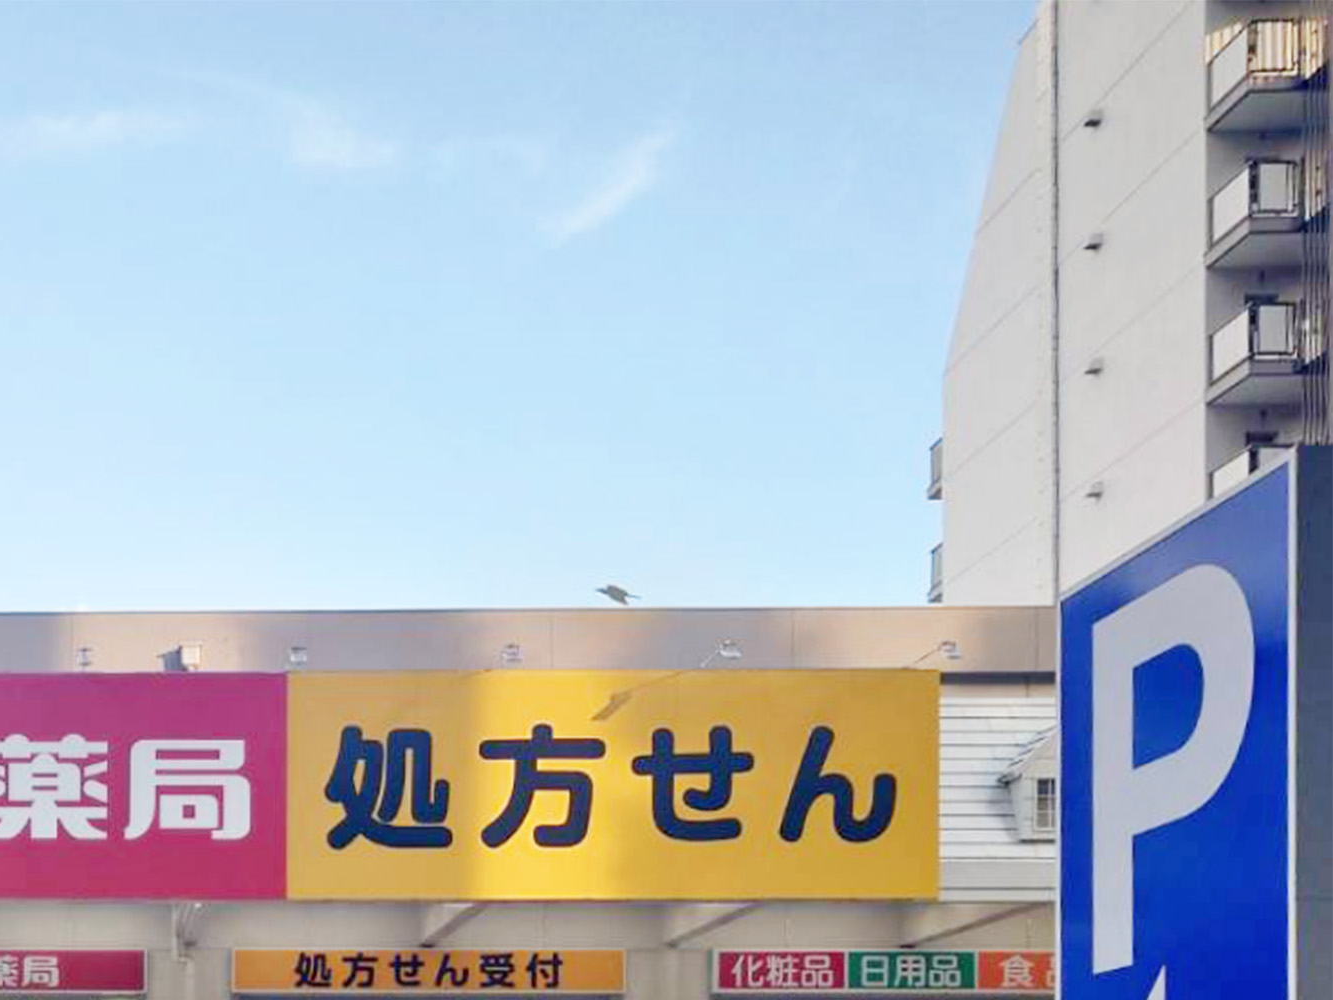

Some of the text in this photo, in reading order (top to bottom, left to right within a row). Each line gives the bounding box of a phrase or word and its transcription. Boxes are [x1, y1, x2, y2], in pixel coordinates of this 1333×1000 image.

[324, 724, 897, 850] 処方せん
[1093, 563, 1255, 975] P
[294, 952, 563, 988] 処方せん受付
[731, 954, 1056, 988] 化粧品 日用品 食
